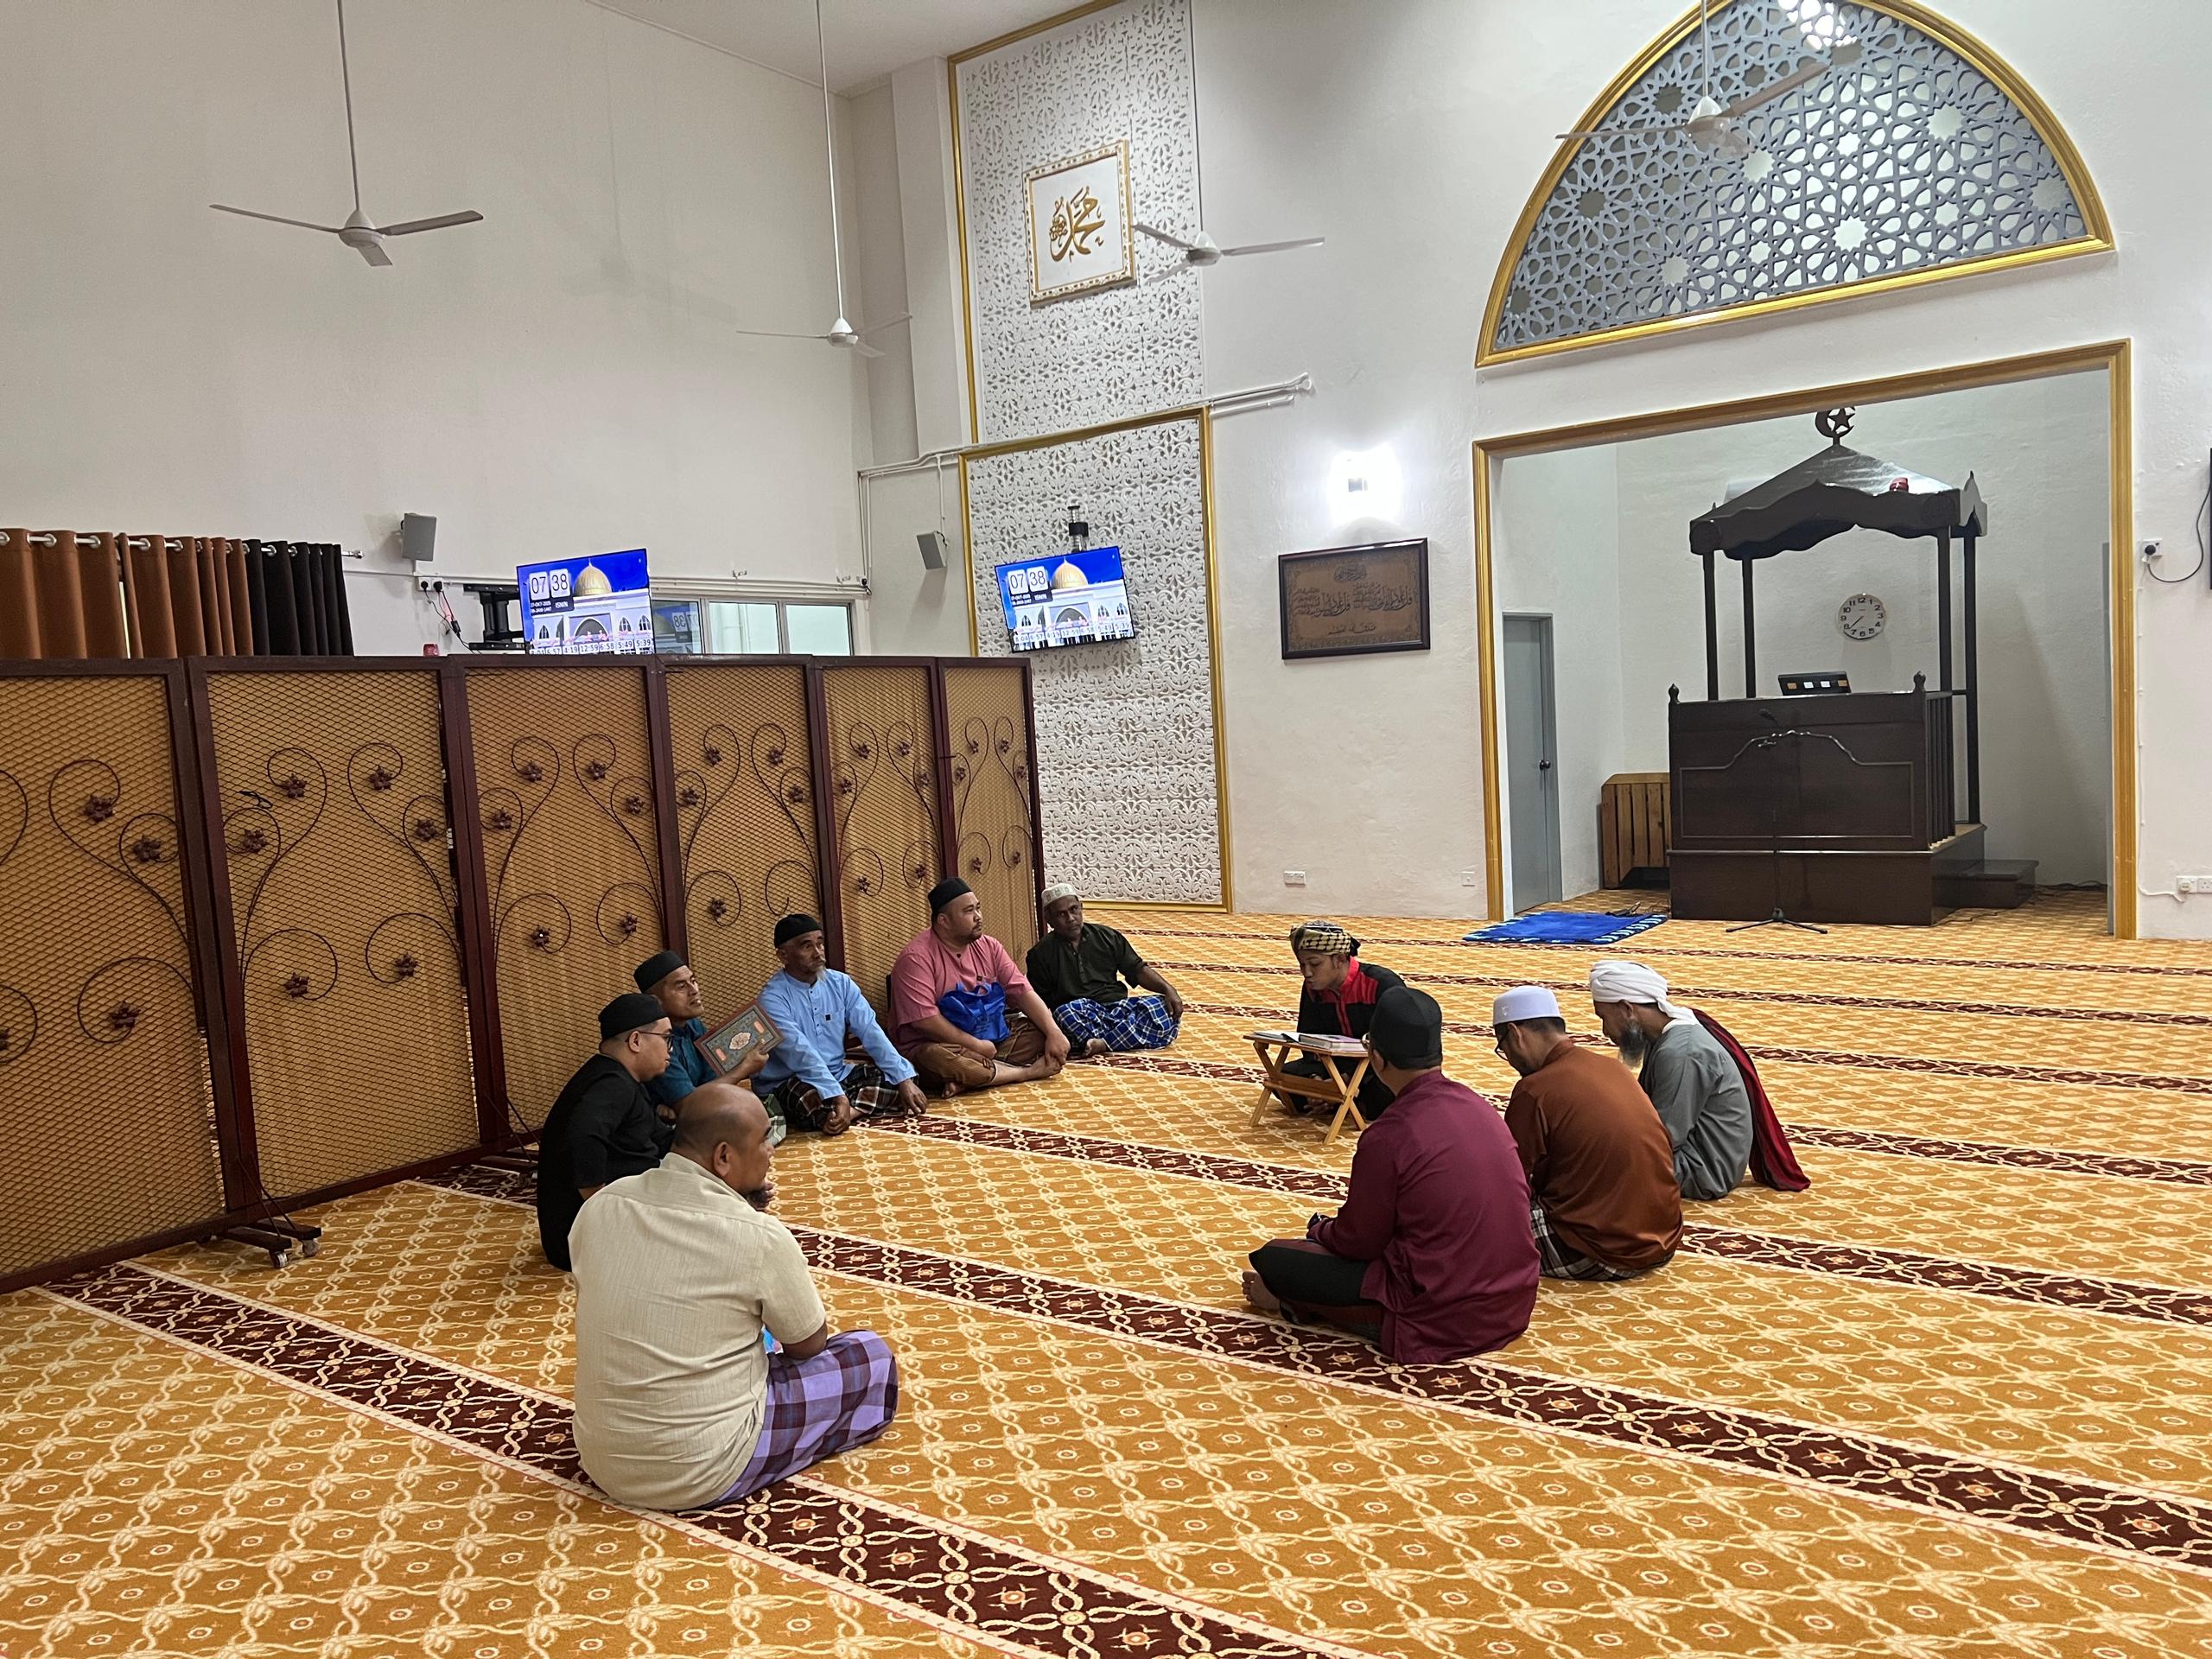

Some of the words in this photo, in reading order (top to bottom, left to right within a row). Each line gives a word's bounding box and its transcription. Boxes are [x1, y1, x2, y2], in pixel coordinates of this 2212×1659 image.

[531, 576, 546, 594] 07
[552, 574, 568, 591] 38
[1010, 574, 1023, 588] 07
[1029, 570, 1046, 586] 38
[581, 644, 598, 652] 12:59
